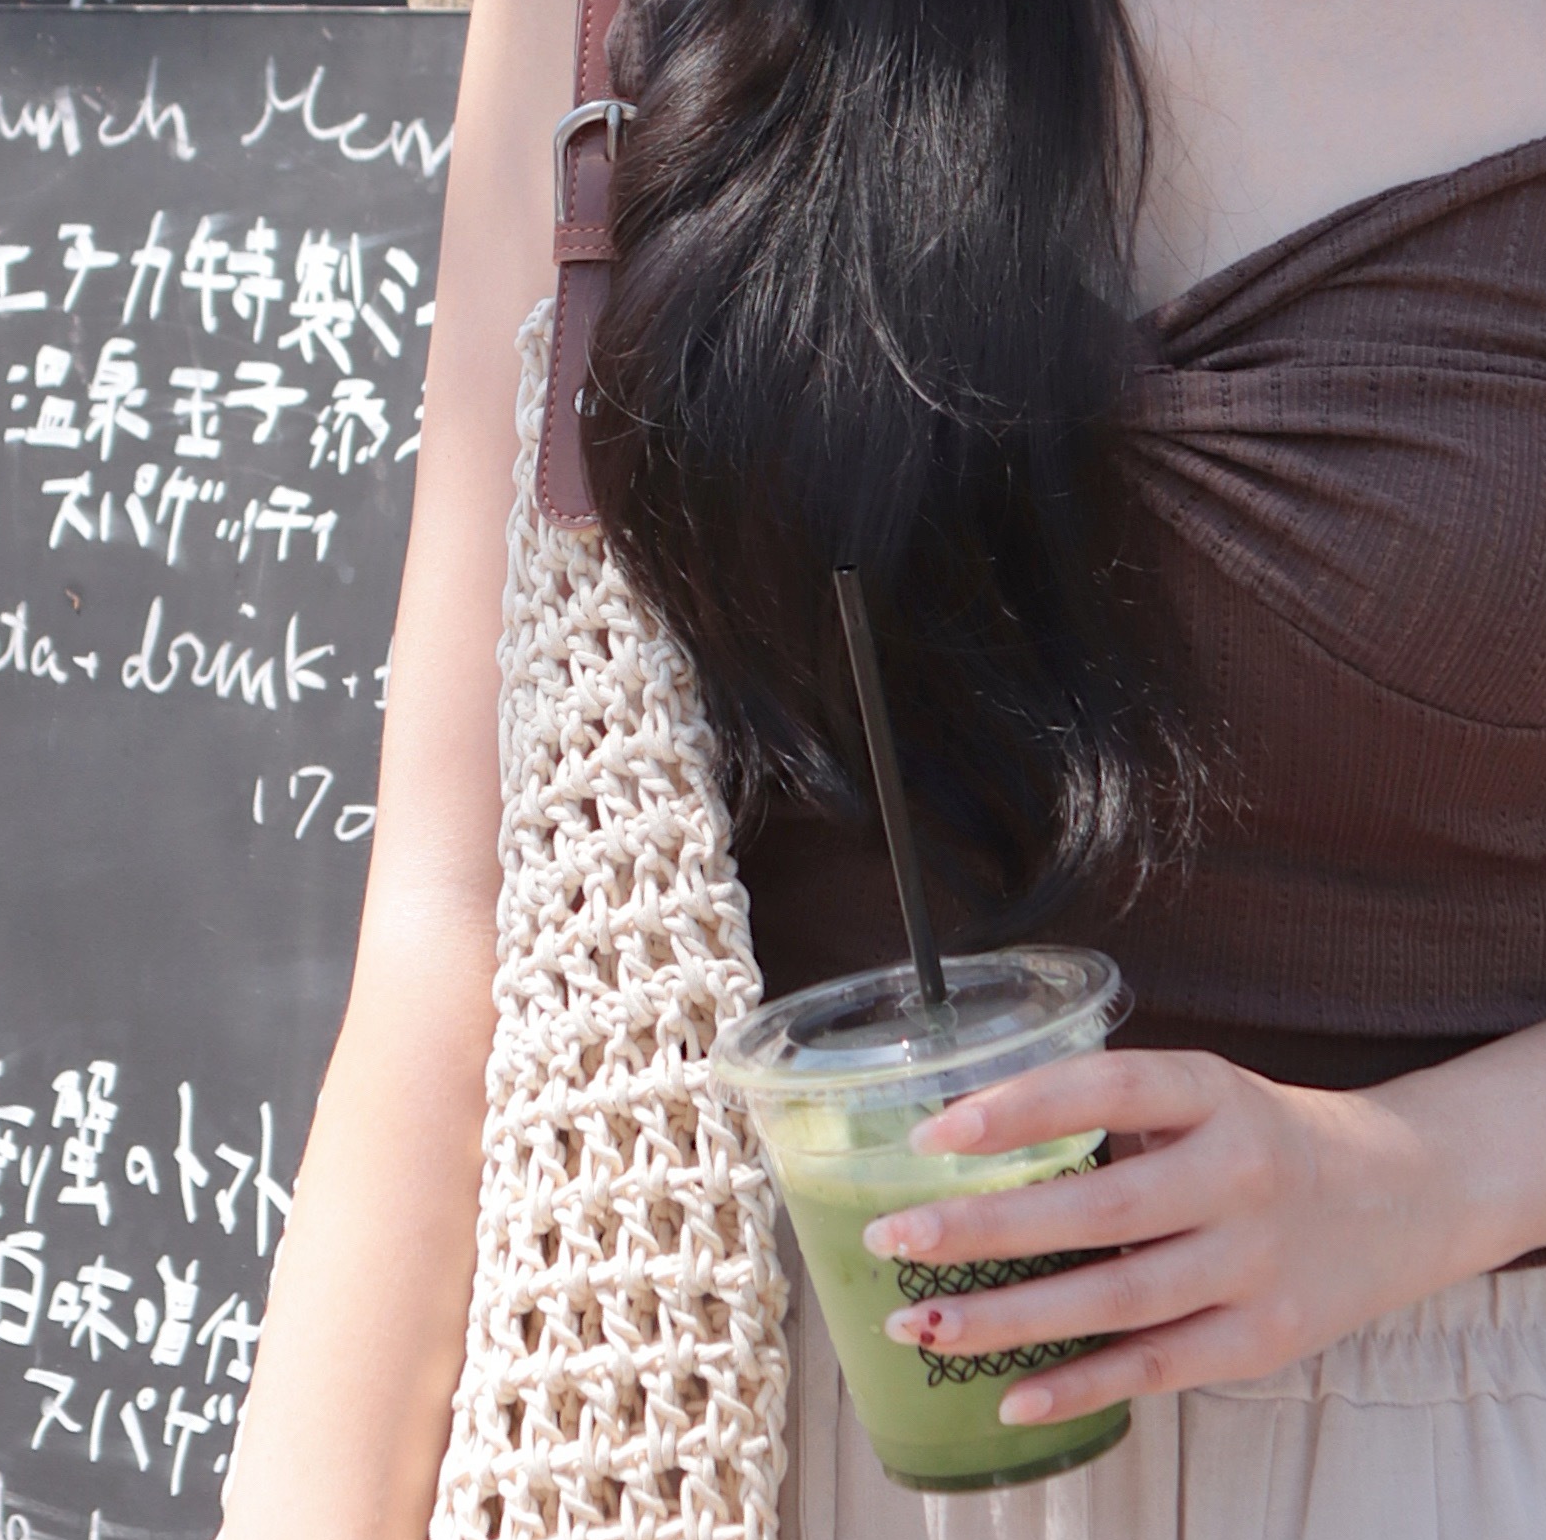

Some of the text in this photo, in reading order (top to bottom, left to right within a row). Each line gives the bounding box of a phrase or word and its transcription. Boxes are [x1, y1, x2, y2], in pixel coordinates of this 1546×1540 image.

[42, 464, 337, 565] スパゲッティ
[25, 1371, 234, 1495] スパゲ
